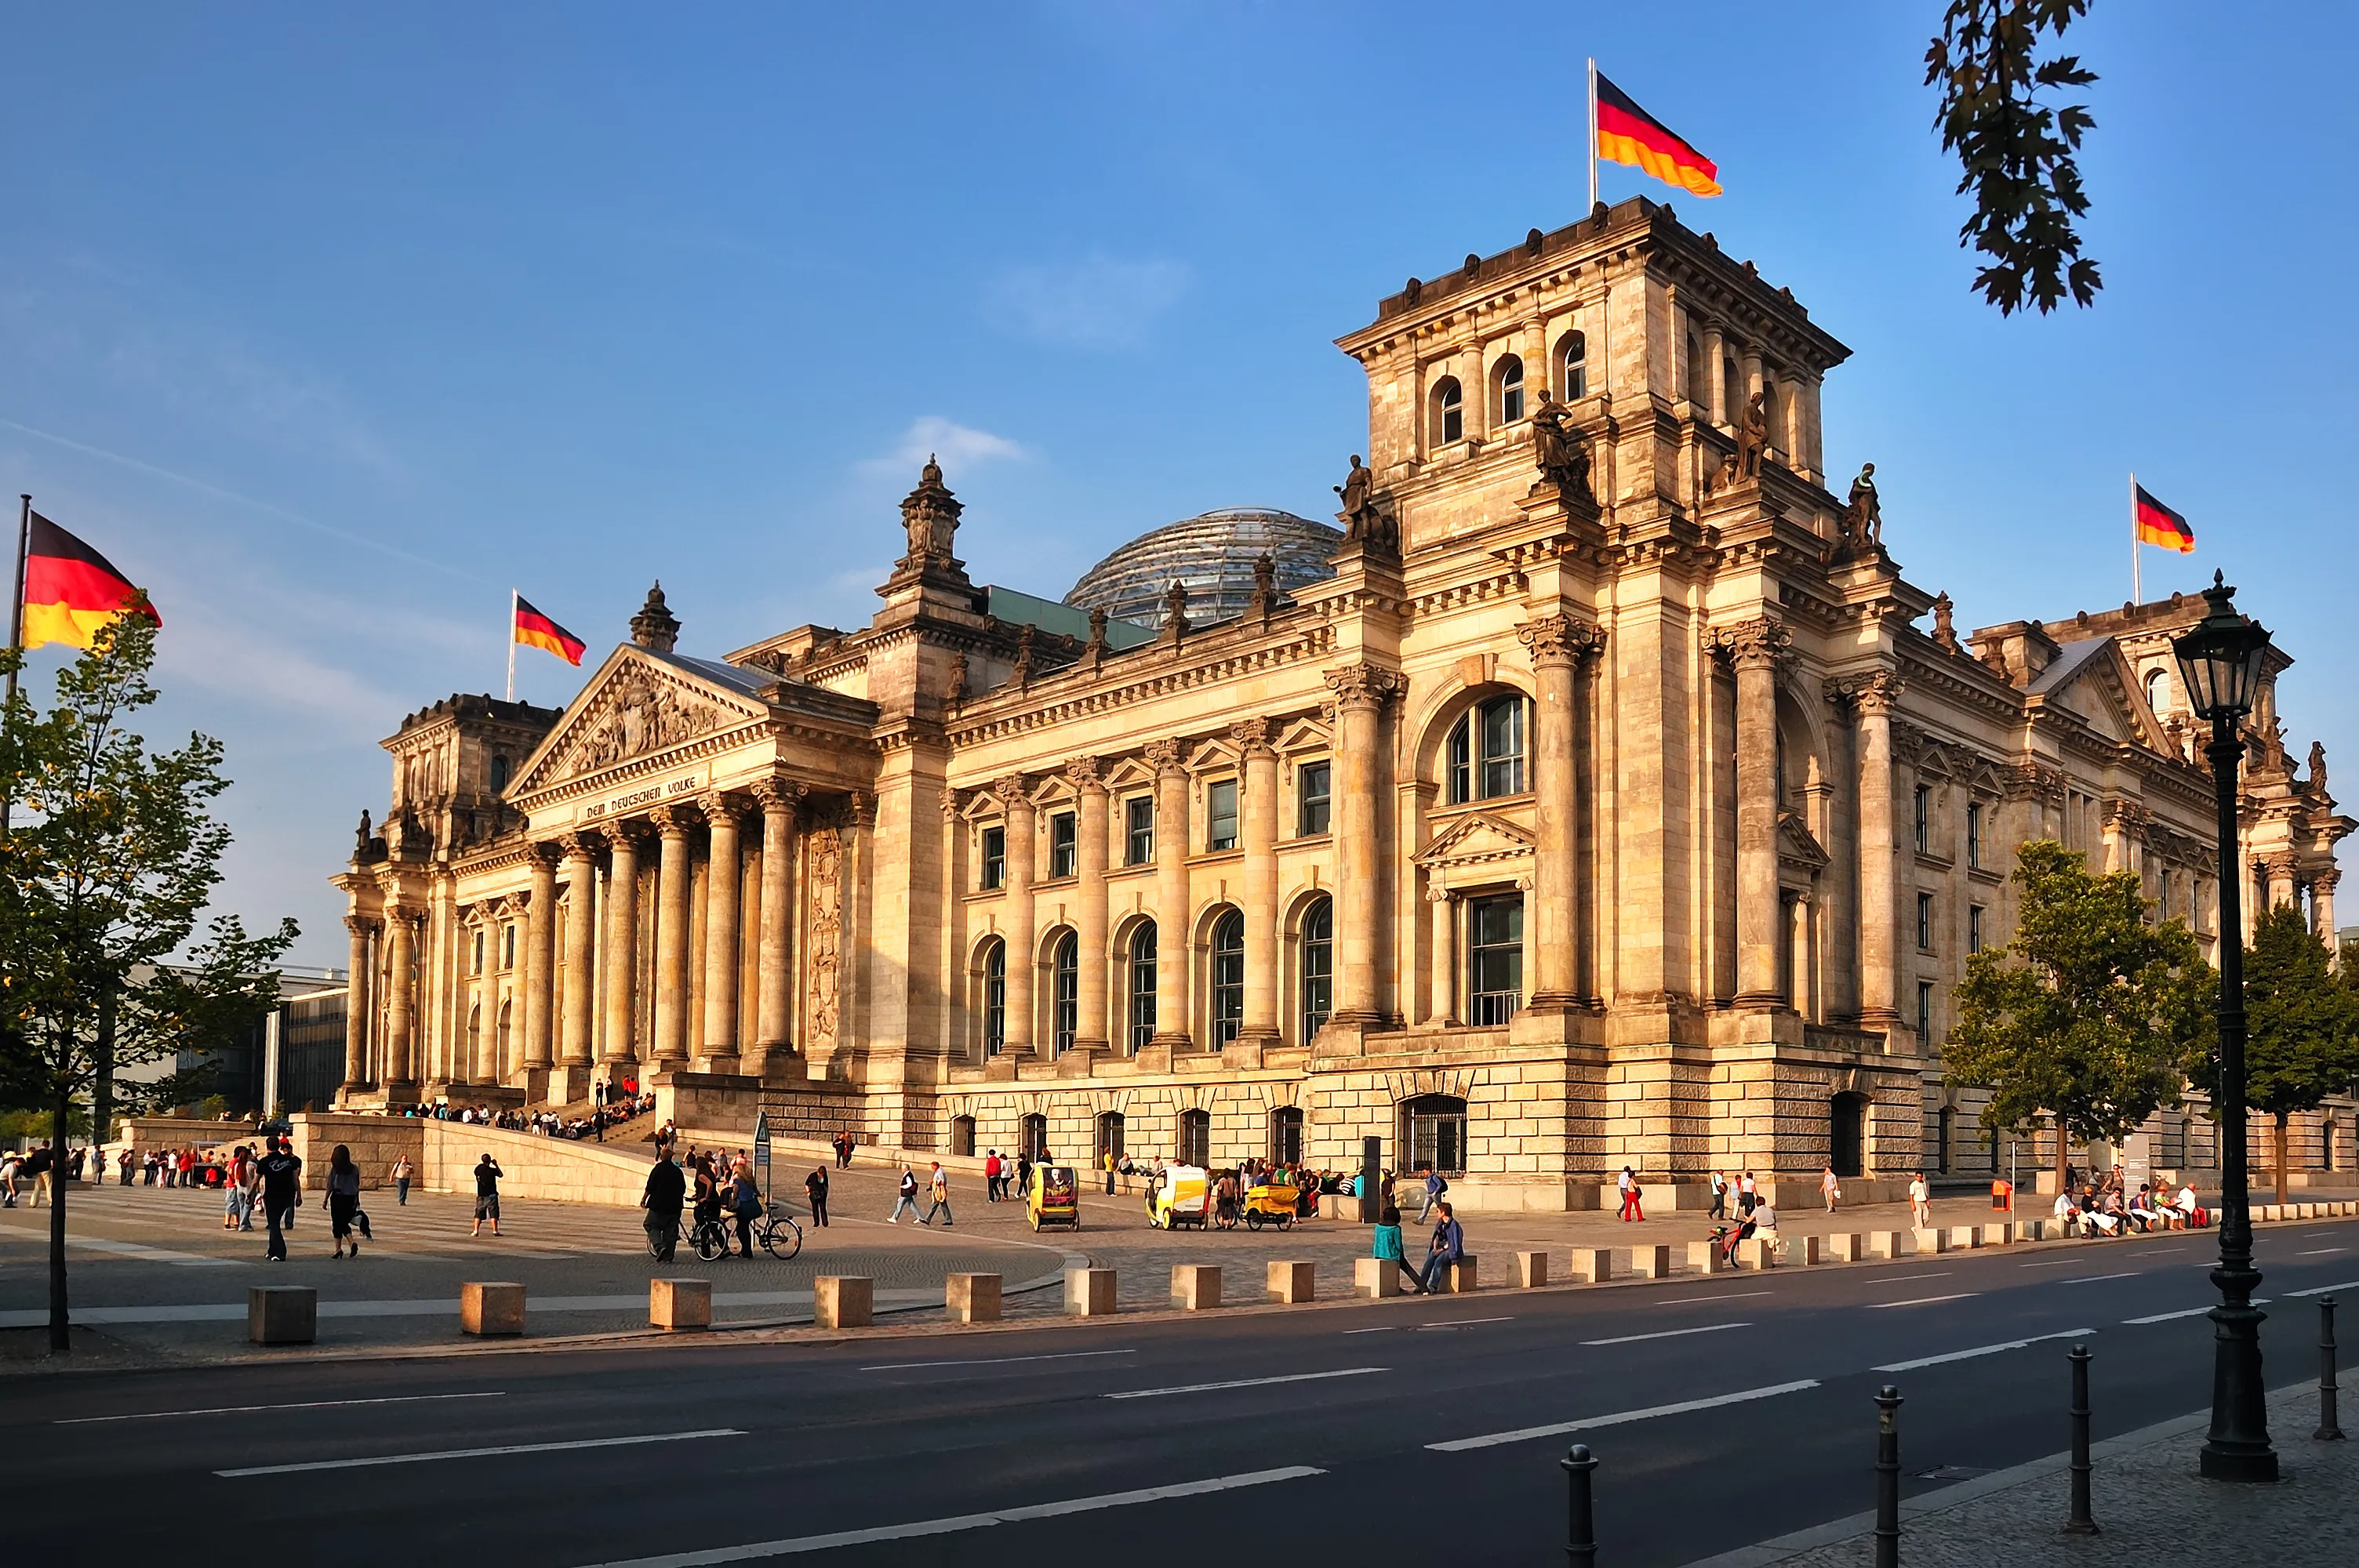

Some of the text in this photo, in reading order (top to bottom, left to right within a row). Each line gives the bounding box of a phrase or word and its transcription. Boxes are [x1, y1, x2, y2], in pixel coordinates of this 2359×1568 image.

[587, 777, 696, 818] DEM DEUTSCHEN VOLKE
